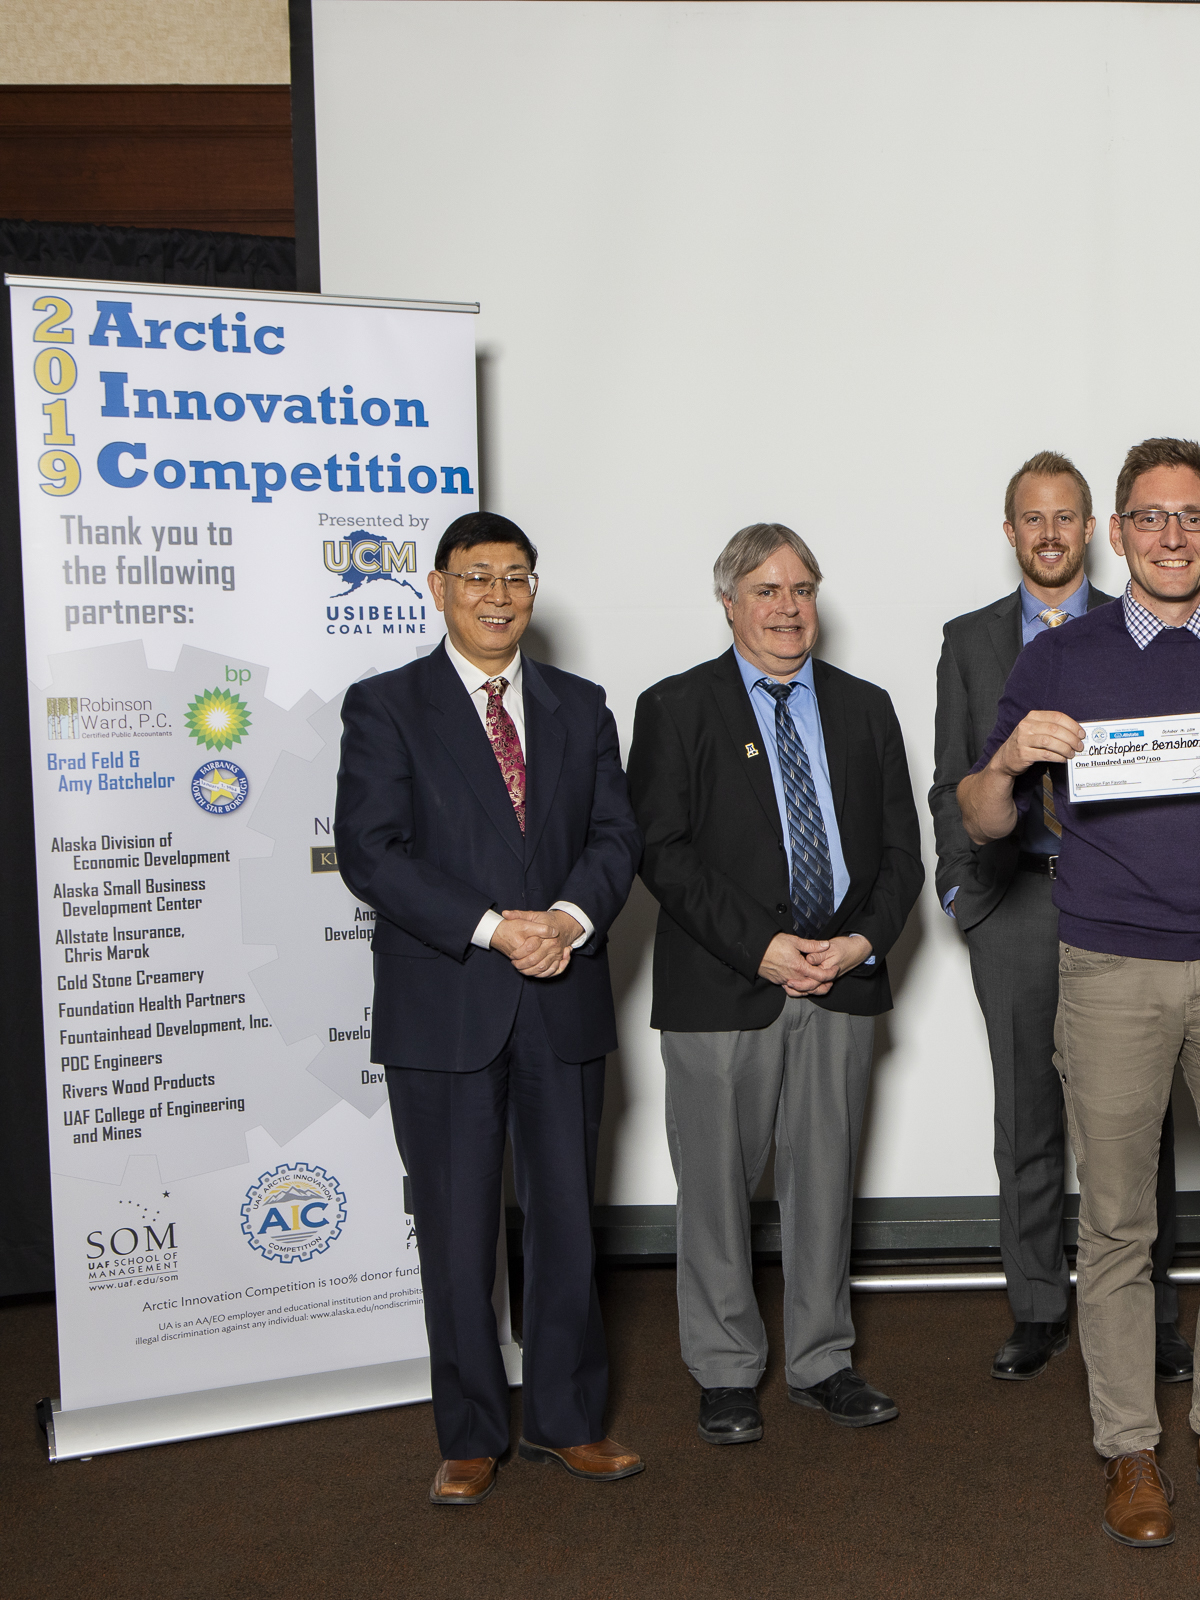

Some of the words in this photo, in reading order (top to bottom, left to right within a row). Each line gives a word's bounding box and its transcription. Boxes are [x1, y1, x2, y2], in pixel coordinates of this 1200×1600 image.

[88, 300, 285, 355] Arctic
[32, 296, 81, 497] 2019
[99, 371, 429, 428] Innovation
[97, 441, 474, 503] Competition
[318, 513, 404, 527] Presented
[408, 514, 429, 531] by
[60, 515, 142, 545] Thank
[151, 526, 198, 552] you
[207, 522, 232, 546] to
[323, 540, 416, 573] UCM
[62, 555, 106, 585] the
[116, 555, 235, 591] following
[65, 600, 194, 631] partners:
[326, 606, 425, 621] USIBELLI
[326, 624, 372, 635] COAL
[383, 624, 426, 634] MINE
[225, 665, 251, 686] bp
[80, 697, 152, 712] Robinson
[81, 714, 133, 730] Ward,
[139, 713, 172, 728] P.C.
[1089, 742, 1148, 756] Christopher
[47, 752, 86, 771] Brad
[92, 751, 124, 769] Feld
[129, 750, 140, 768] &
[1091, 759, 1121, 767] Hundred
[58, 775, 92, 795] Amy
[98, 771, 175, 790] Batchelor
[51, 836, 97, 853] Alaska
[101, 835, 155, 850] Division
[159, 832, 172, 847] of
[73, 854, 140, 870] Economic
[144, 850, 230, 867] Development
[53, 882, 99, 899] Alaska
[103, 879, 141, 896] Small
[146, 878, 206, 893] Business
[63, 900, 152, 918] Development
[157, 896, 202, 911] Center
[55, 929, 108, 945] Allstate
[113, 926, 185, 941] Insurance,
[65, 947, 102, 963] Chris
[107, 943, 150, 960] Marok
[57, 974, 88, 991] Cold
[92, 973, 132, 988] Stone
[136, 970, 204, 985] Creamery
[59, 1000, 134, 1018] Foundation
[139, 994, 182, 1012] Health
[186, 993, 245, 1008] Partners
[60, 1023, 152, 1045] Fountainhead
[156, 1018, 245, 1037] Development,
[249, 1014, 272, 1029] Inc.
[61, 1055, 89, 1072] PDC
[94, 1054, 162, 1071] Engineers
[62, 1084, 108, 1099] Rivers
[112, 1077, 149, 1095] Wood
[154, 1073, 215, 1091] Products
[64, 1109, 90, 1126] UAF
[95, 1106, 145, 1123] College
[150, 1102, 163, 1118] of
[167, 1097, 245, 1118] Engineering
[73, 1127, 98, 1144] and
[102, 1126, 142, 1141] Mines
[253, 1193, 263, 1210] UAF
[263, 1175, 290, 1193] ARCTIC
[293, 1174, 332, 1201] INNOVATION
[257, 1202, 329, 1235] AIC
[86, 1222, 178, 1259] SOM
[268, 1236, 322, 1252] COMPETITION
[88, 1260, 110, 1270] UAF
[114, 1254, 159, 1267] SCHOOL
[163, 1252, 177, 1261] OF
[88, 1261, 178, 1279] MANAGEMENT
[88, 1270, 178, 1291] www.uaf.edu/som
[142, 1299, 178, 1312] Arctic
[181, 1291, 242, 1306] Innovation
[245, 1281, 315, 1297] Competition
[318, 1278, 327, 1287] is
[329, 1273, 358, 1286] 100%
[360, 1271, 393, 1282] donor
